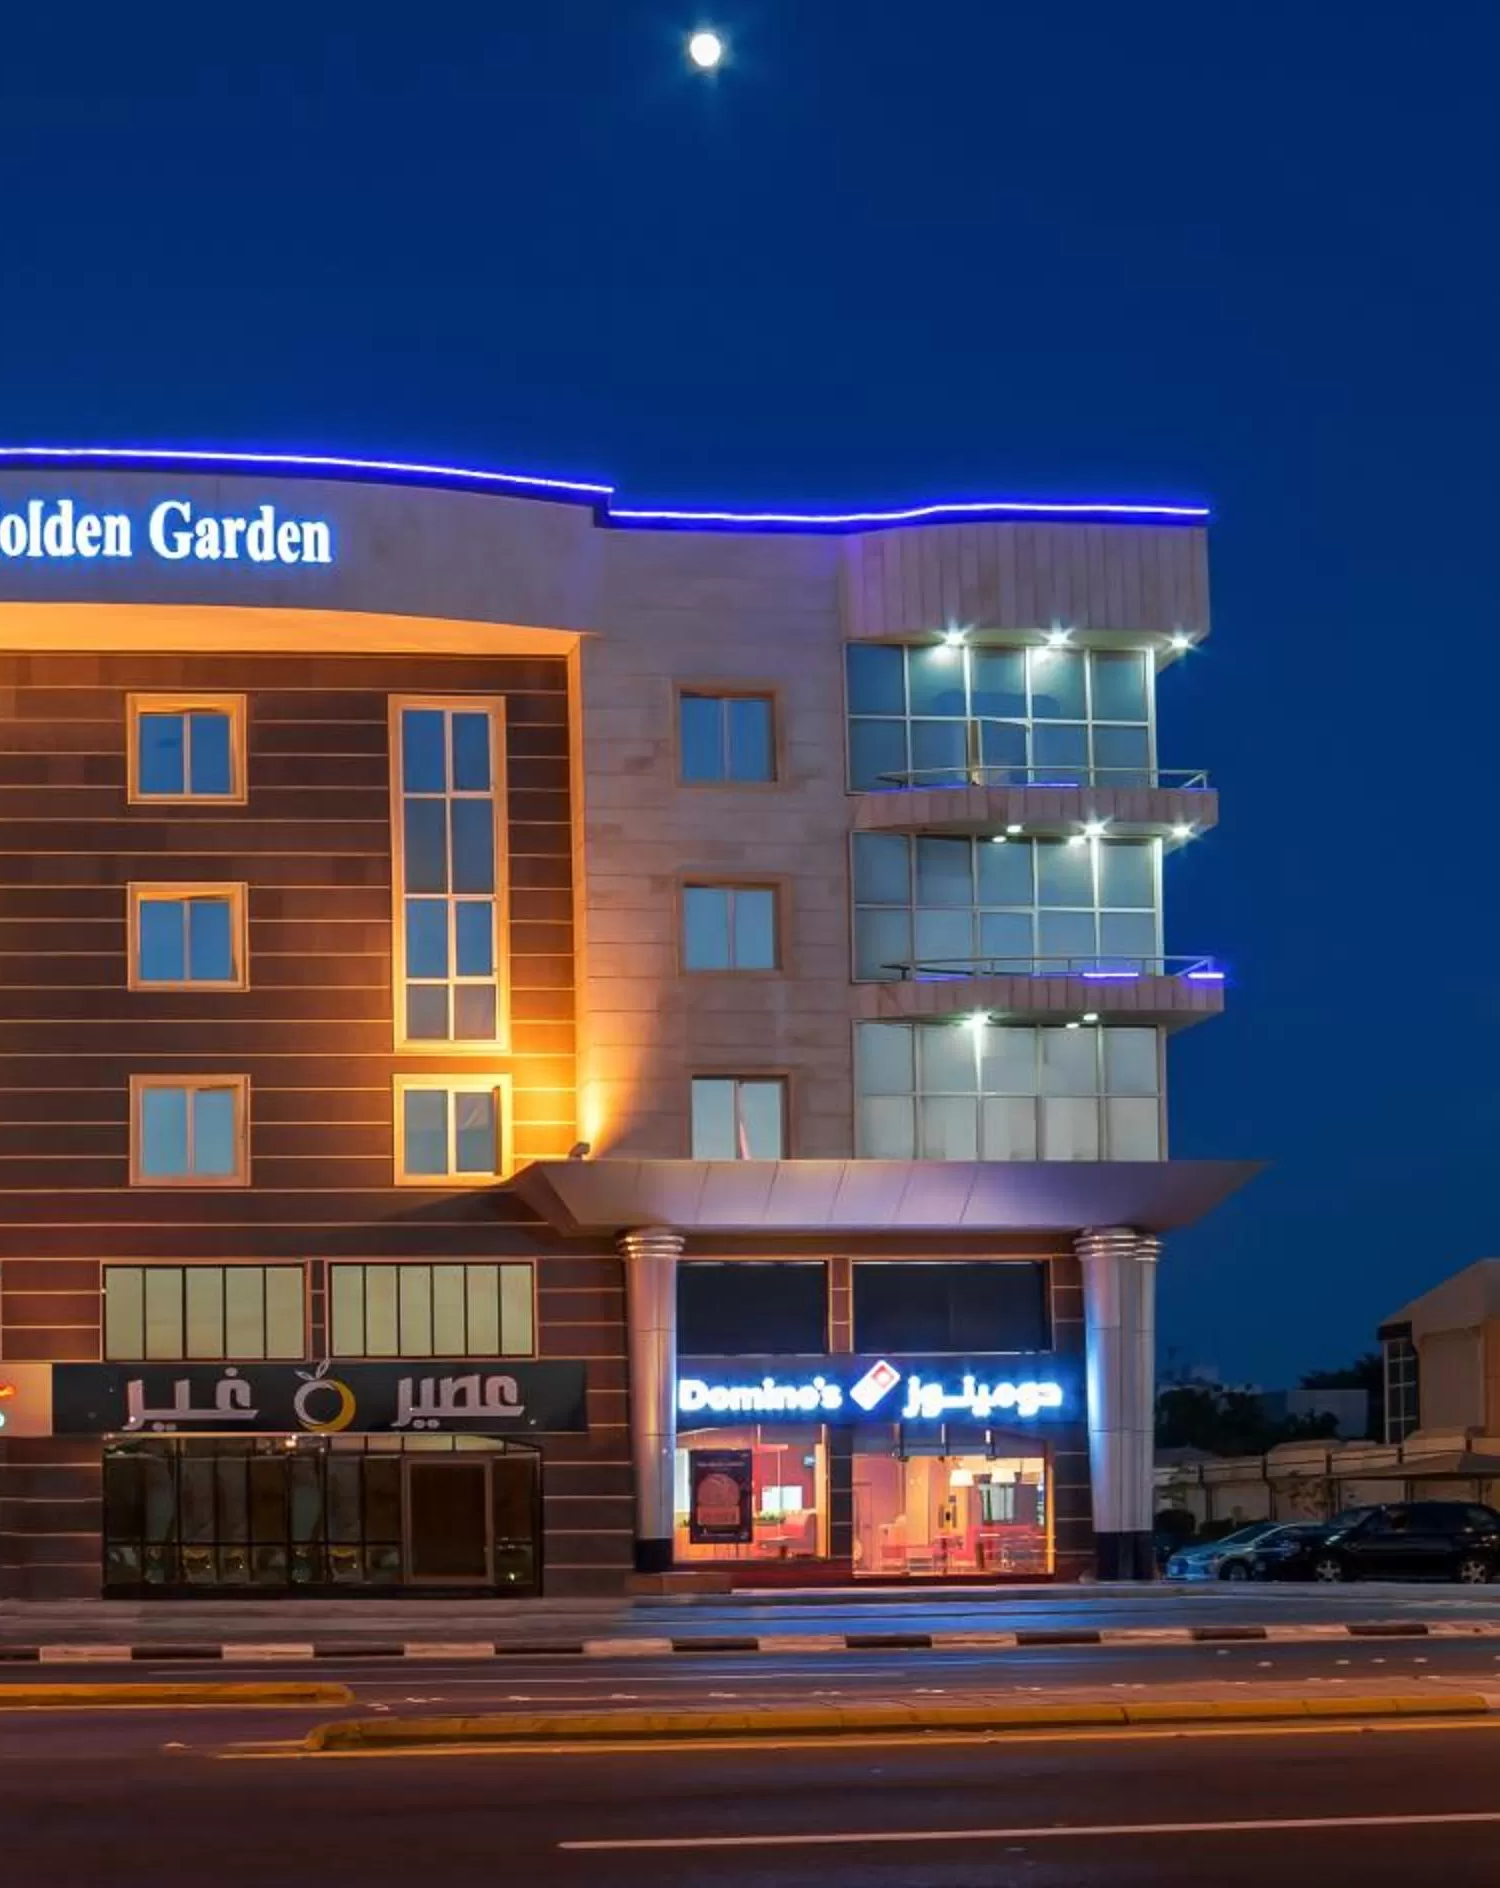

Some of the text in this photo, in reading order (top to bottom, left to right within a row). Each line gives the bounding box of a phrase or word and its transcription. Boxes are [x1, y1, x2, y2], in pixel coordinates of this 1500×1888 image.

[149, 500, 332, 564] Garden
[121, 1366, 526, 1432] عصير غير
[679, 1375, 843, 1411] Domino's
[902, 1375, 1063, 1419] دومينوز
